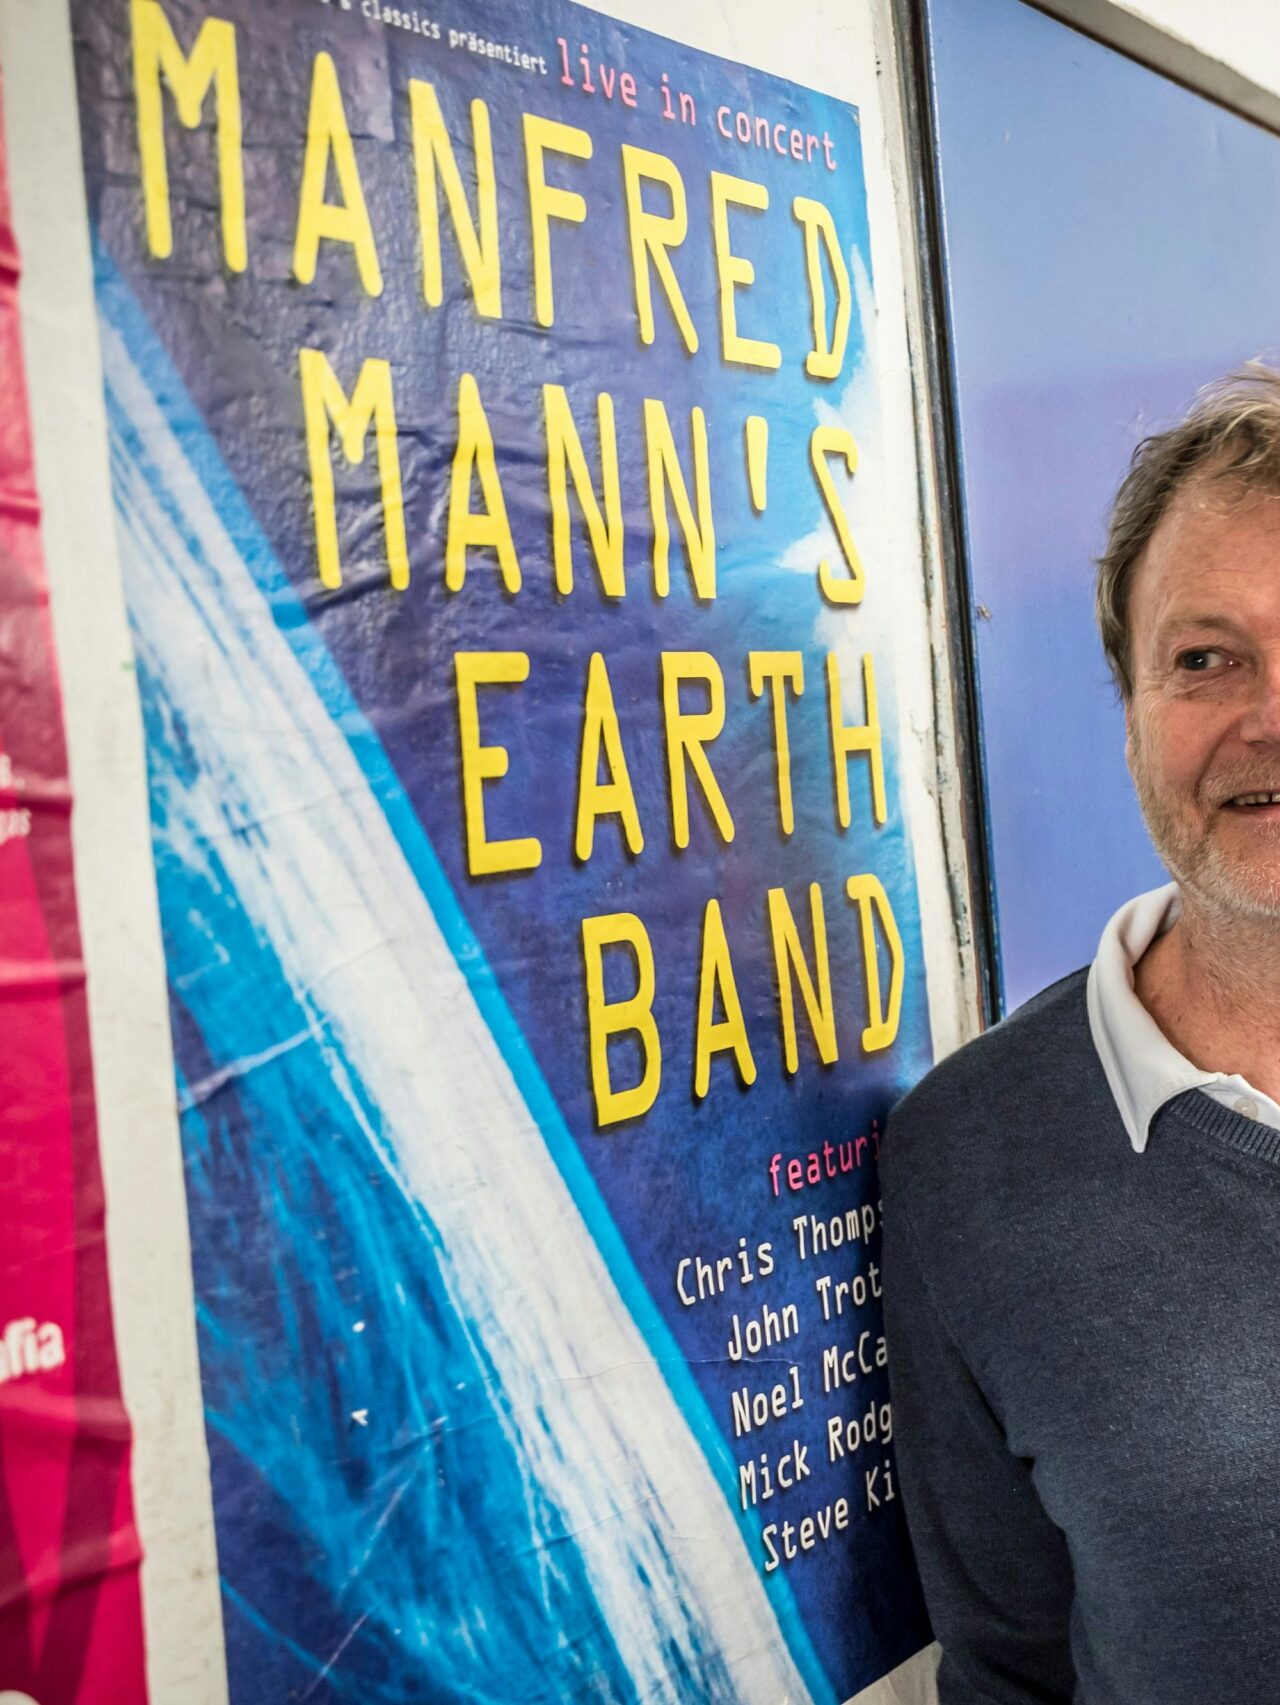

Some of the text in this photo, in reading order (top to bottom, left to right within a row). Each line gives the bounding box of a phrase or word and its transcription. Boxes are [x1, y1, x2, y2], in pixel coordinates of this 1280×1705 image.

[361, 0, 548, 75] classics präsentiert
[556, 37, 838, 171] live in concert
[130, 0, 852, 381] MANFRED
[300, 348, 866, 605] MANN'S
[454, 650, 889, 877] EARTH
[582, 873, 906, 1127] BAND
[676, 1237, 774, 1306] Chris
[728, 1266, 882, 1361] John Trot
[731, 1330, 888, 1437] Noel McCa
[739, 1400, 893, 1511] Mick Rodg
[762, 1460, 896, 1573] Steve Ki
